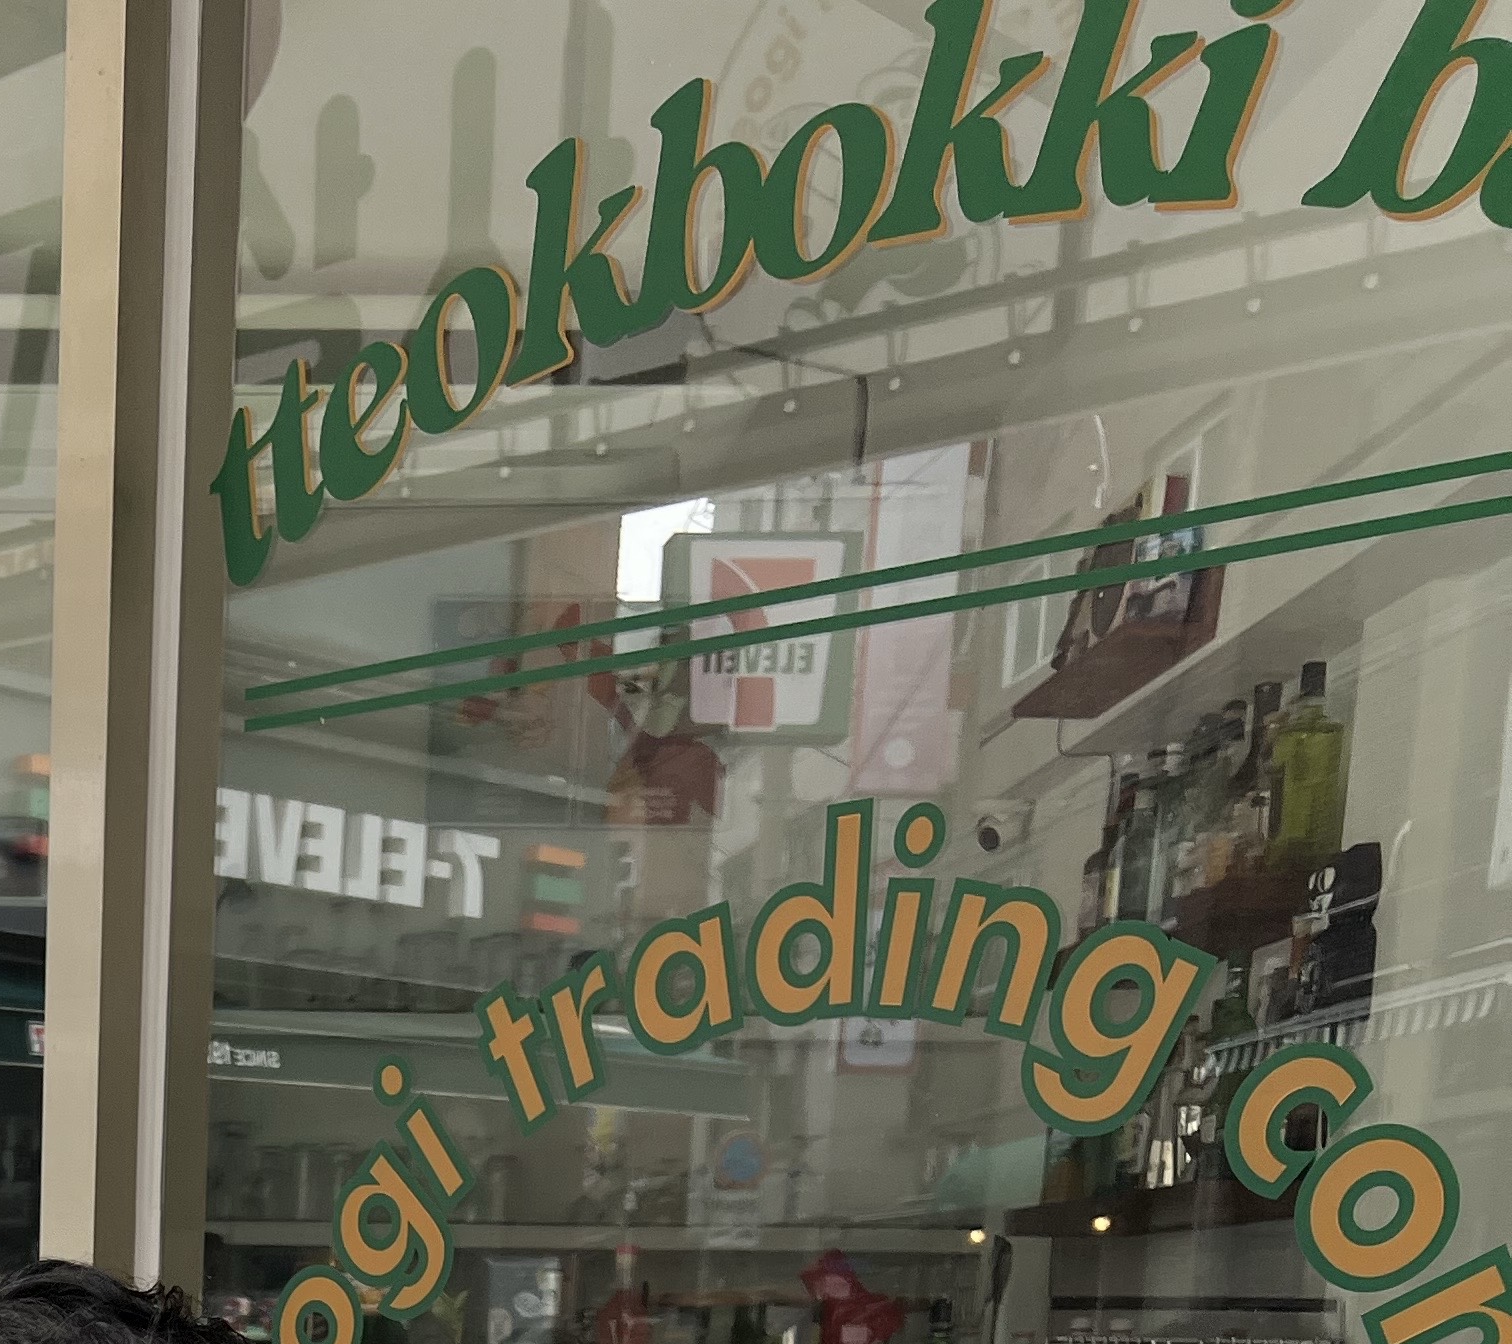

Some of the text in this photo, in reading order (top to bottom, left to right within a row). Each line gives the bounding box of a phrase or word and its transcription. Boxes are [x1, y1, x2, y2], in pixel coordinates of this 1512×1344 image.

[208, 0, 1512, 586] tteokbokki b
[474, 797, 1218, 1137] trading
